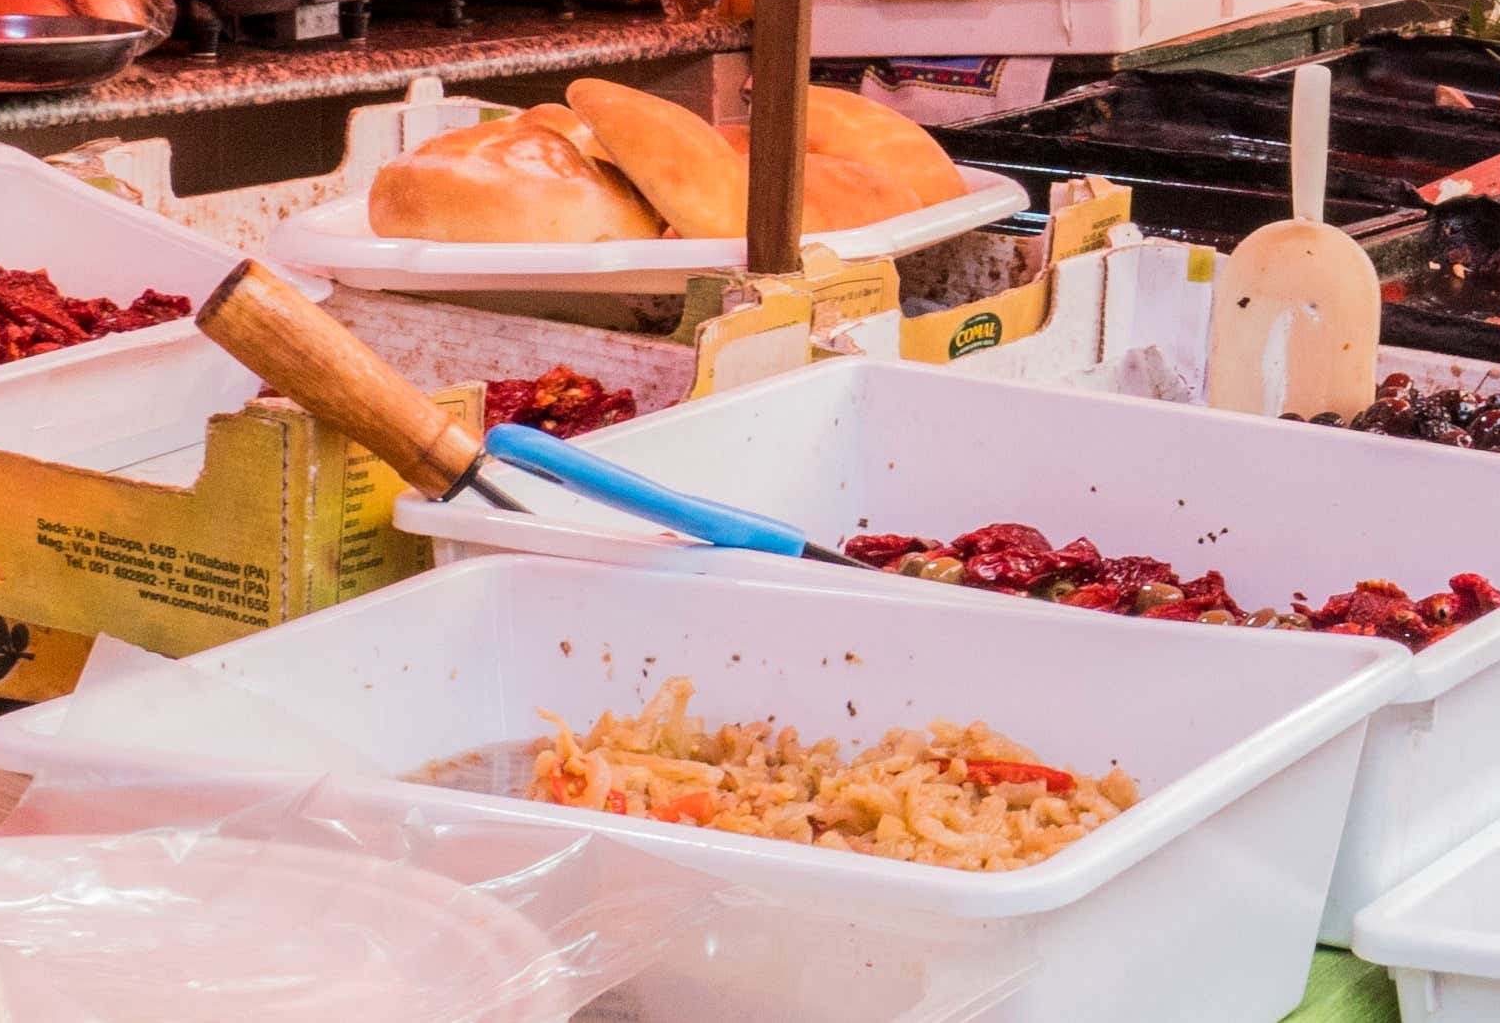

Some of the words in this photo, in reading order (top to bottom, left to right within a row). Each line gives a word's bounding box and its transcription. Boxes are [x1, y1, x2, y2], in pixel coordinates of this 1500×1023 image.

[72, 542, 92, 557] Via
[244, 581, 271, 598] (PA)
[99, 531, 147, 555] Europa,
[244, 565, 271, 581] (PA)
[168, 578, 190, 595] Fax
